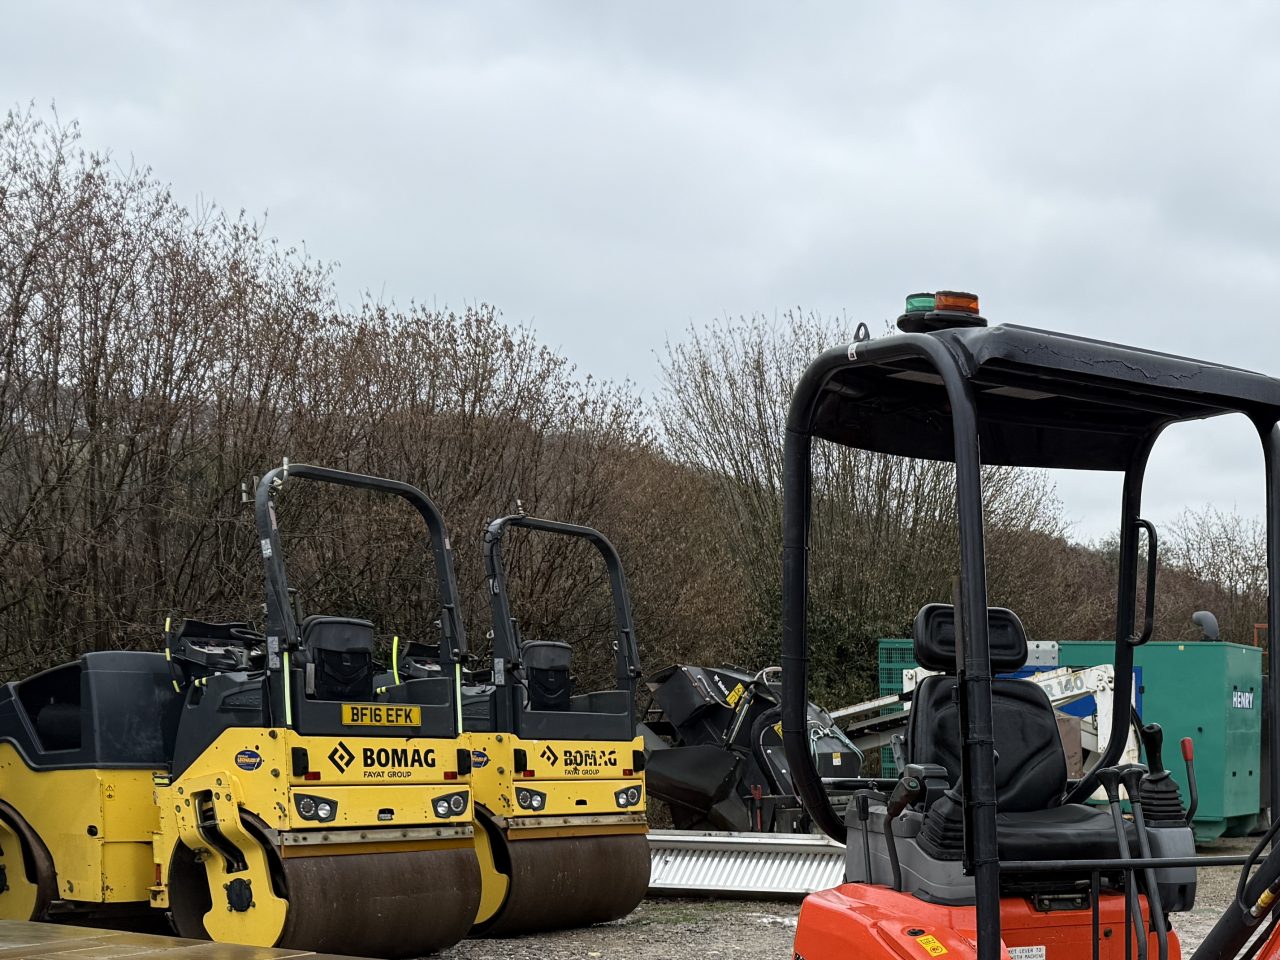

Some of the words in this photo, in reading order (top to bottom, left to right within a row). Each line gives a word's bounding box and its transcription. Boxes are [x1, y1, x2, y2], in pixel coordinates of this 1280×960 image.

[1059, 676, 1084, 695] 140
[1232, 691, 1254, 709] HENRY
[350, 706, 382, 723] BF16
[386, 708, 413, 724] EFK
[362, 747, 436, 768] BOMAG
[563, 749, 617, 767] BOMAG
[363, 770, 385, 778] FAYAT
